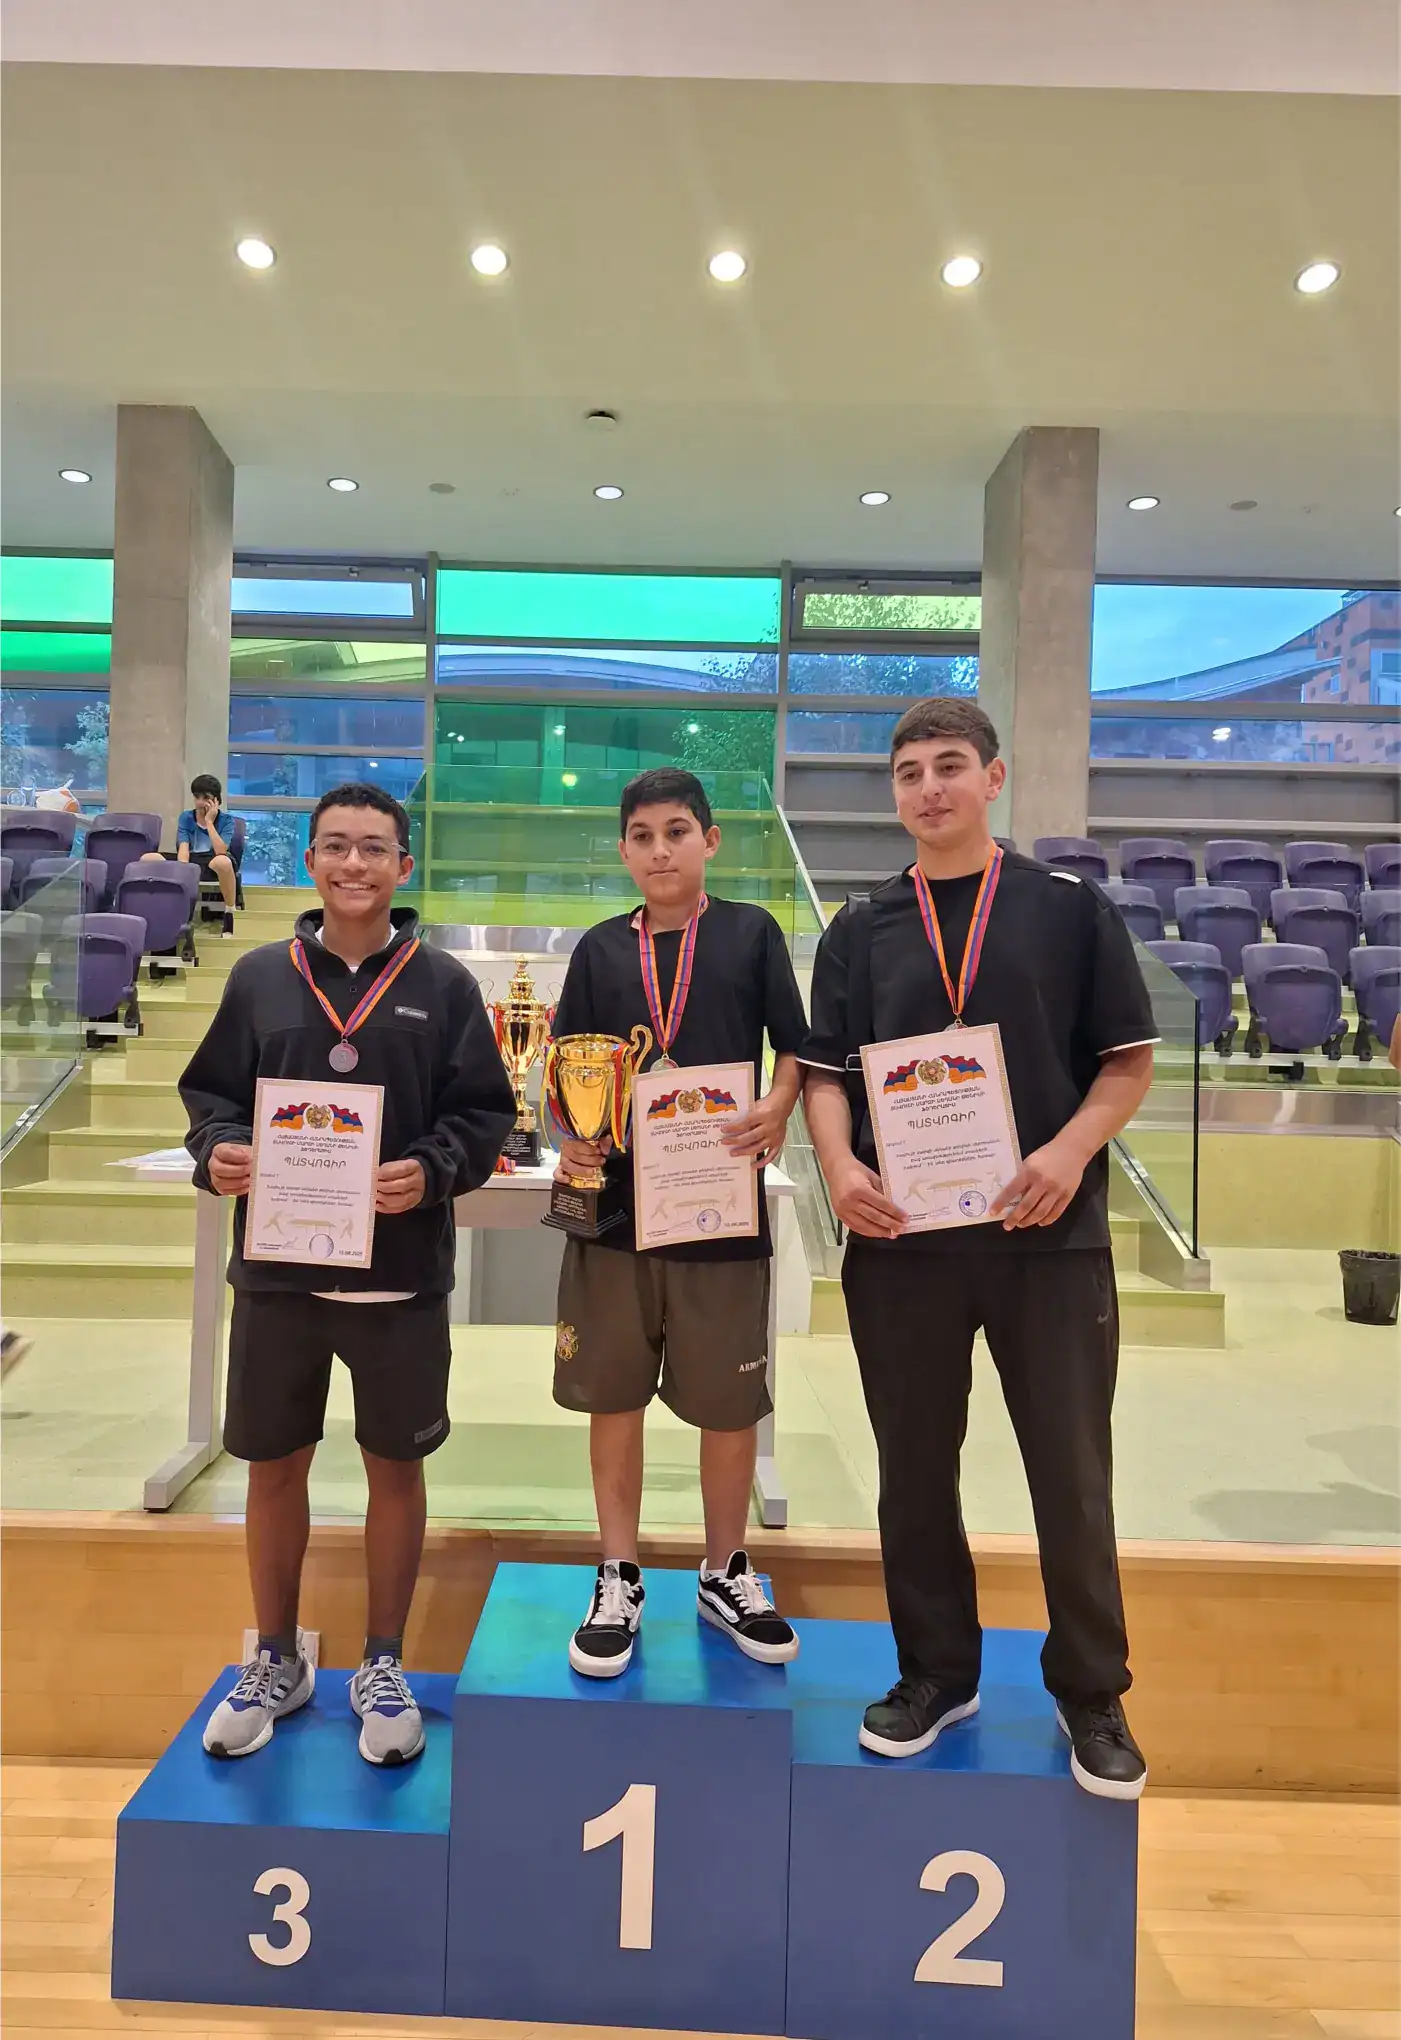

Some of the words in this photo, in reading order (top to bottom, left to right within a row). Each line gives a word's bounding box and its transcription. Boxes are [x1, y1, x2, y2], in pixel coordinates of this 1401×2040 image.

[907, 1110, 976, 1130] ՊԱՏՎՈԳԻՐ
[284, 1156, 347, 1170] ՊԱՏՎՈԳԻՐ
[738, 1354, 767, 1372] ARMA
[583, 1784, 656, 1949] 1
[249, 1868, 310, 1965] 3
[914, 1850, 1005, 1986] 2
